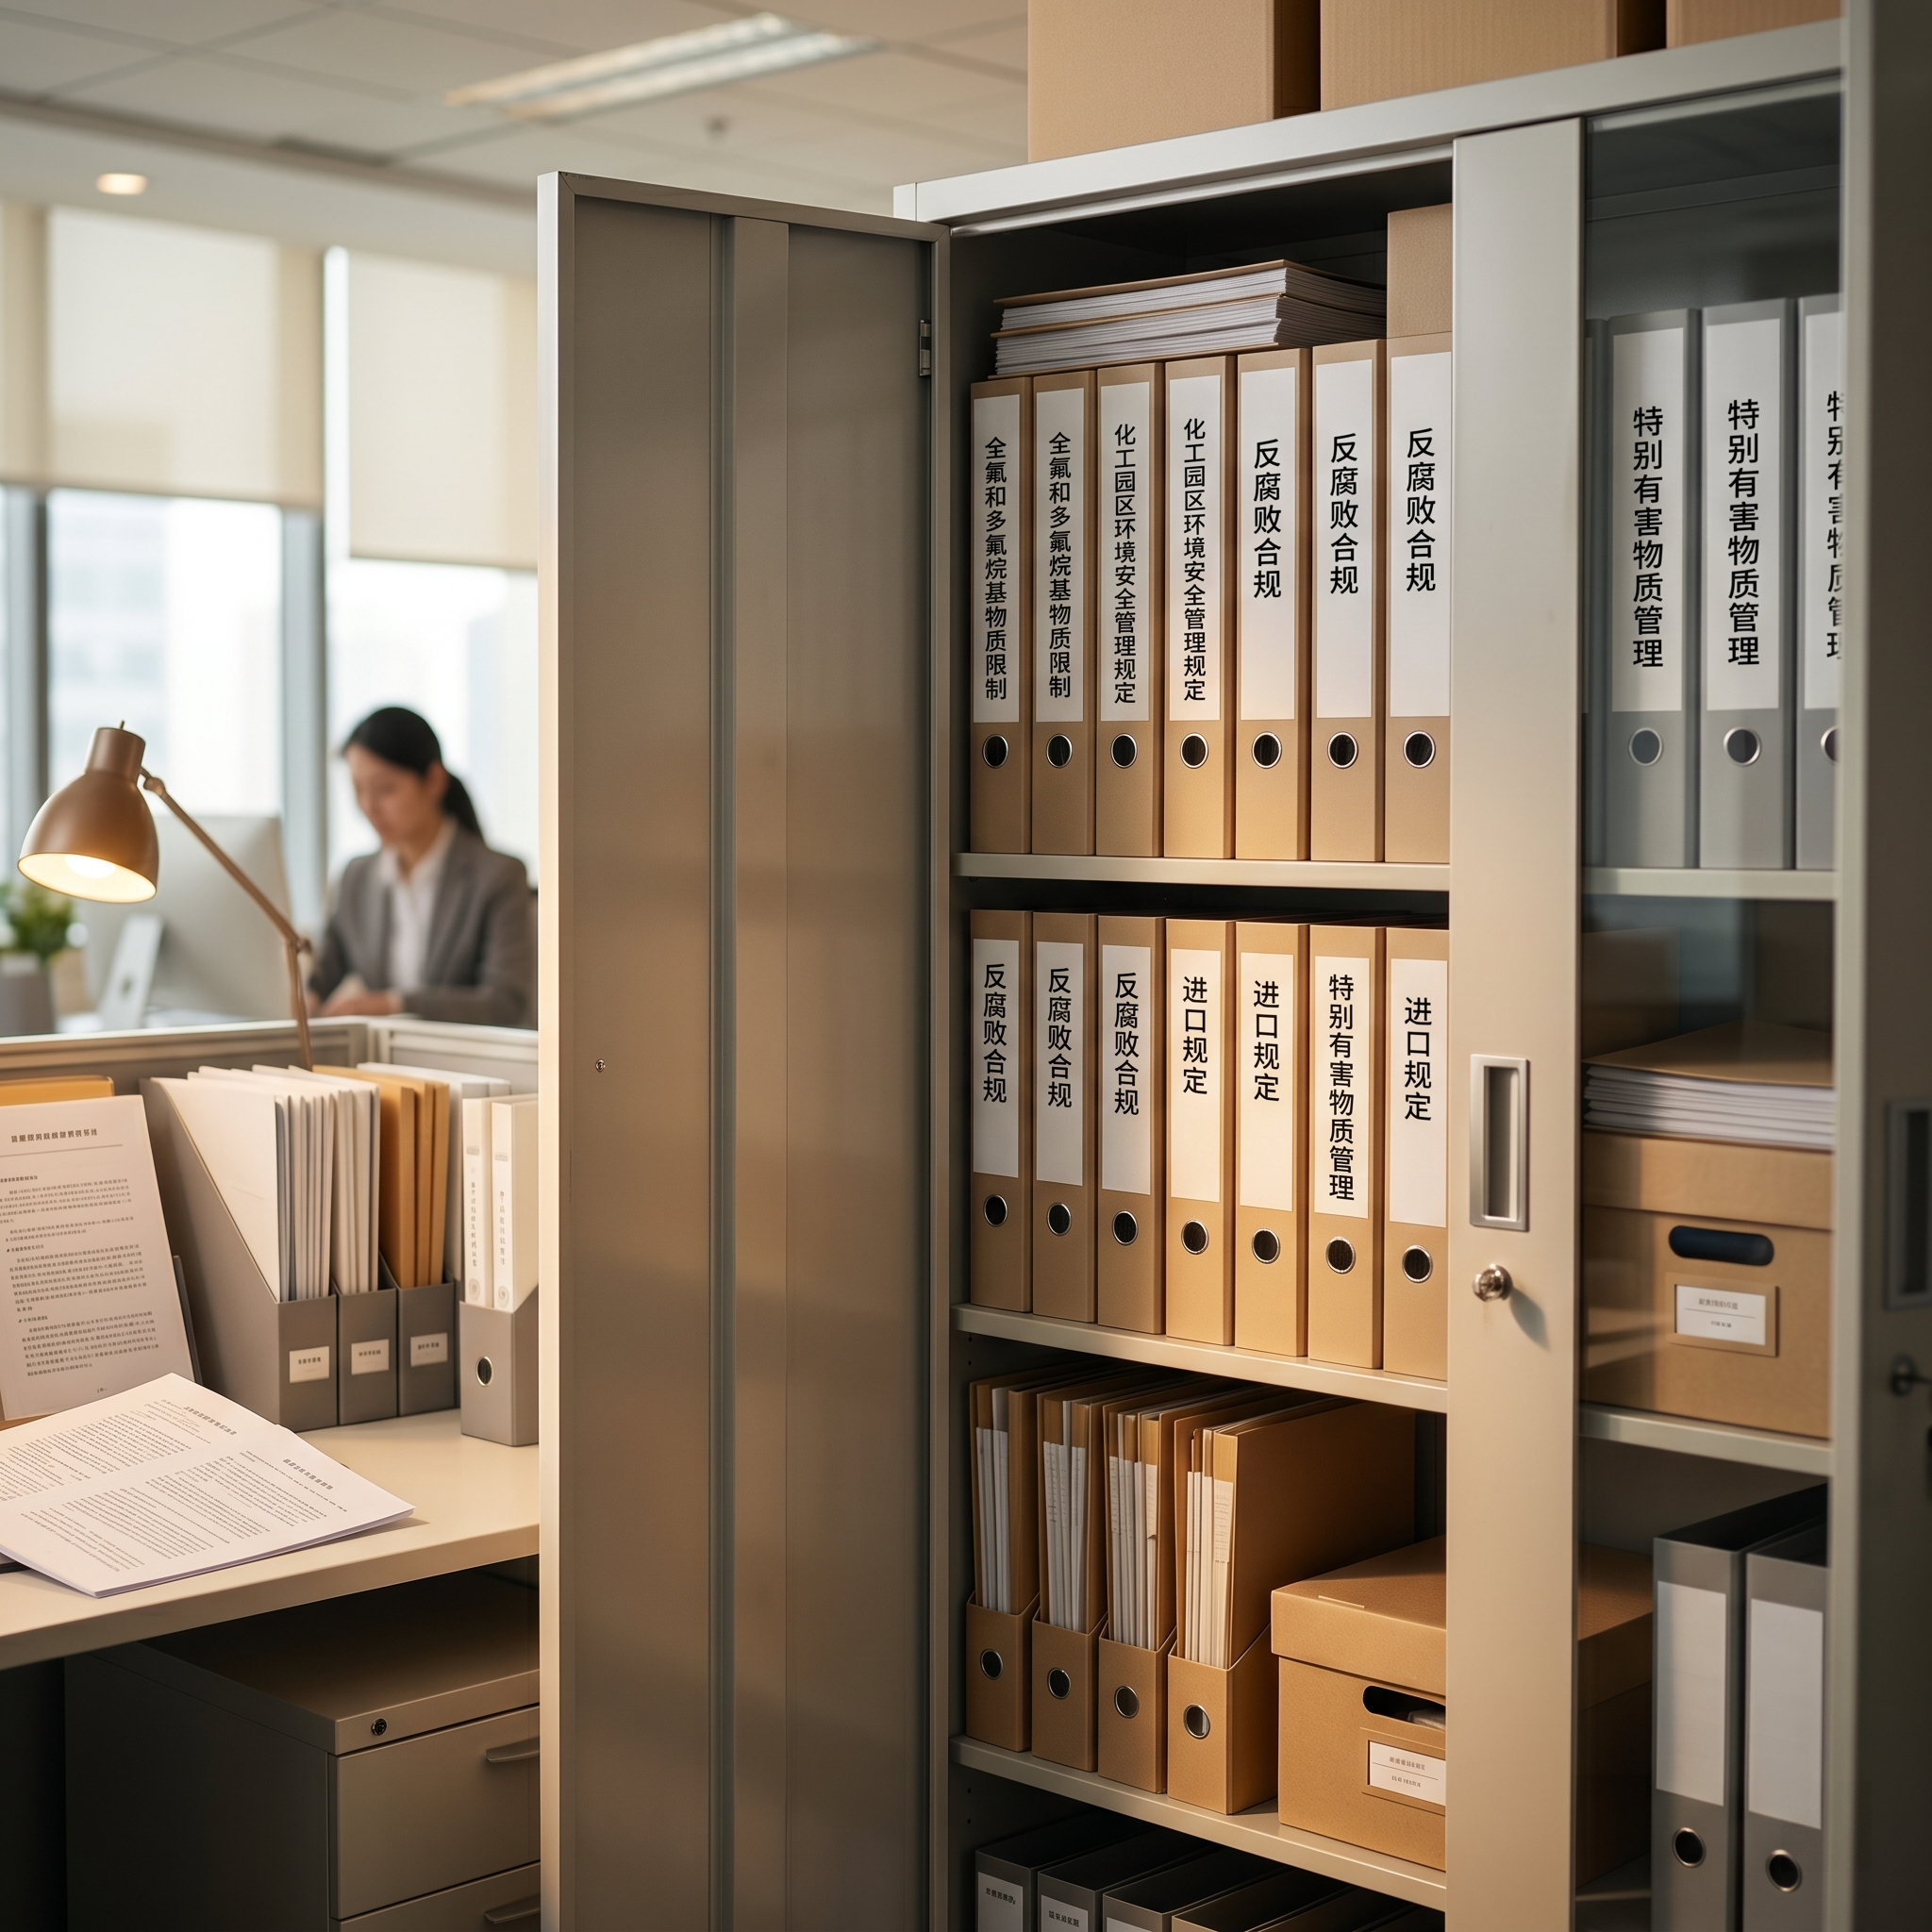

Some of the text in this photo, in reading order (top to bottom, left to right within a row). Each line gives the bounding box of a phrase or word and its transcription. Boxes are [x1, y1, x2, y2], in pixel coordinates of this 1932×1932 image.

[1114, 423, 1137, 704] 化工园区环境安全管理规定
[1183, 418, 1207, 701] 化工园区环境安全管理规定
[1253, 438, 1282, 599] 反腐败合规
[1329, 433, 1359, 594] 反腐败合规
[1406, 427, 1437, 592] 反腐败合规
[1633, 406, 1664, 668] 特别有害物质管理
[1728, 398, 1760, 666] 特别有害物质管理
[983, 963, 1008, 1104] 反腐败合规
[1047, 967, 1073, 1108] 反腐败合规
[1114, 972, 1140, 1116] 反腐败合规
[1182, 975, 1208, 1095] 进口规定
[1253, 980, 1280, 1102] 进口规定
[1328, 974, 1355, 1201] 特别有害物质管理
[1404, 996, 1433, 1122] 进口规定
